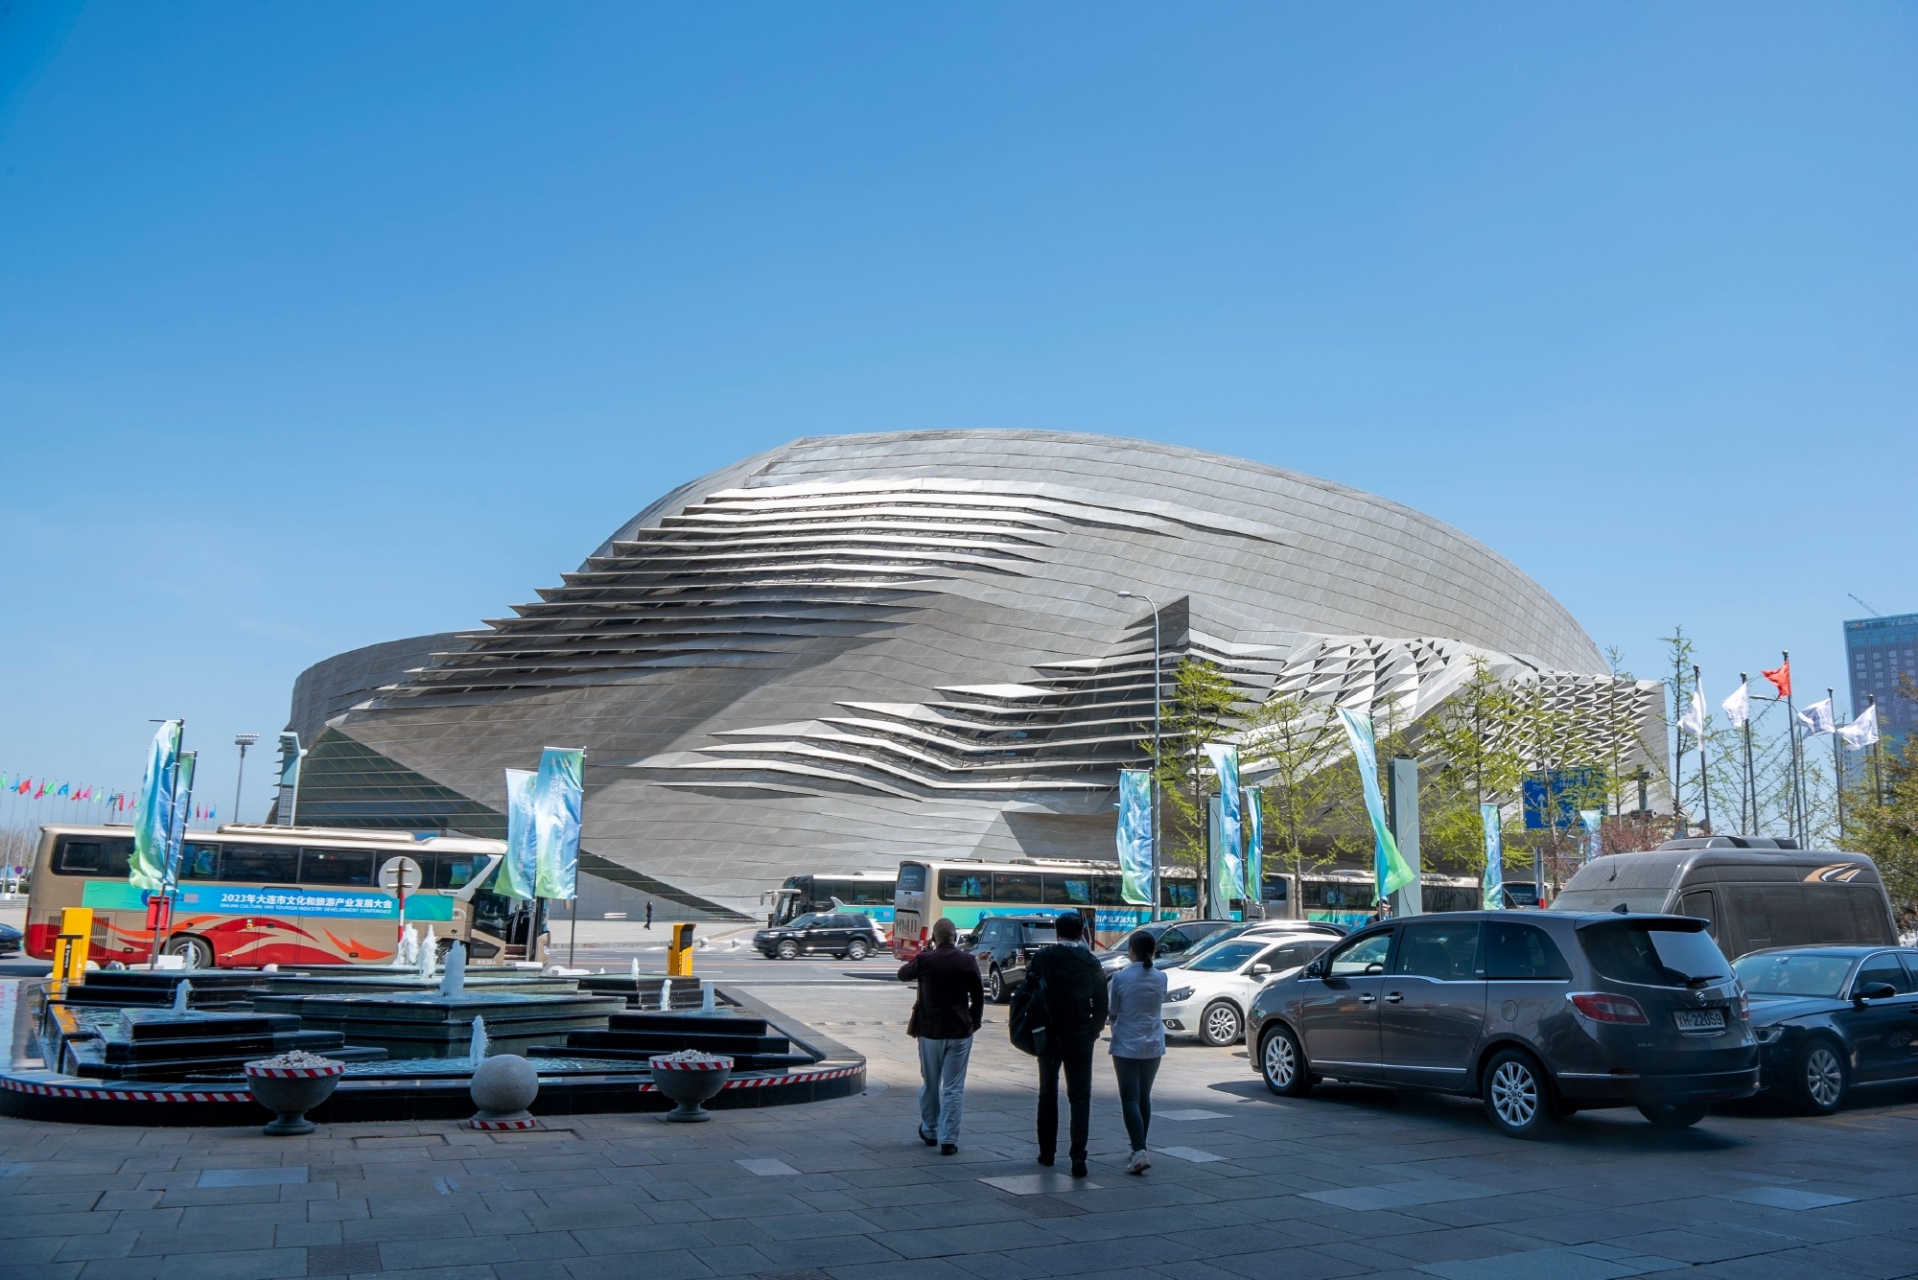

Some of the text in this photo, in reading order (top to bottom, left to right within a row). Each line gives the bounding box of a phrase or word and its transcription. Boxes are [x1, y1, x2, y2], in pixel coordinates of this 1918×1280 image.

[221, 893, 393, 909] 2023年大连市文化和旅游产业发展大会
